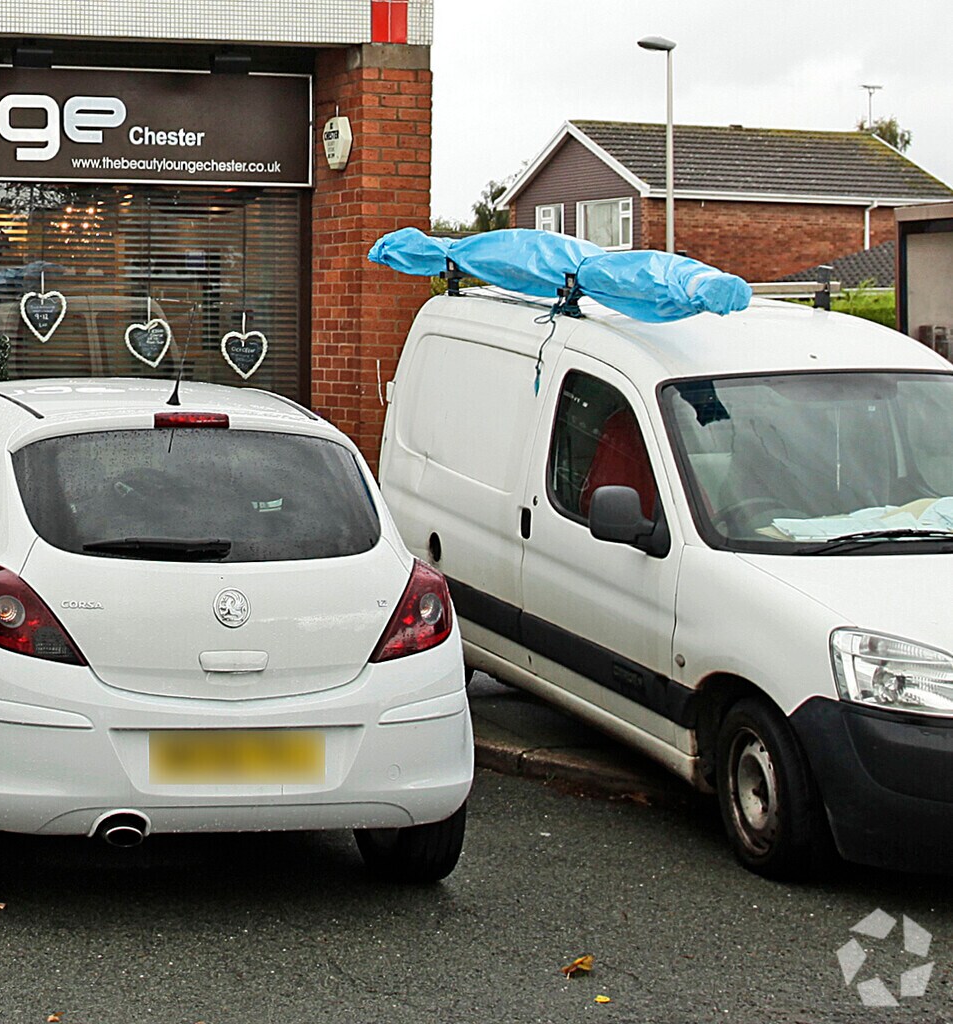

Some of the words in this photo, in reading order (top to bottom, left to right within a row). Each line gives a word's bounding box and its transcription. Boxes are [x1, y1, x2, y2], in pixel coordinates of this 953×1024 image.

[129, 126, 206, 147] Chester
[71, 157, 281, 173] www.thebeautyloungechester.co.uk
[60, 600, 105, 610] CORSA
